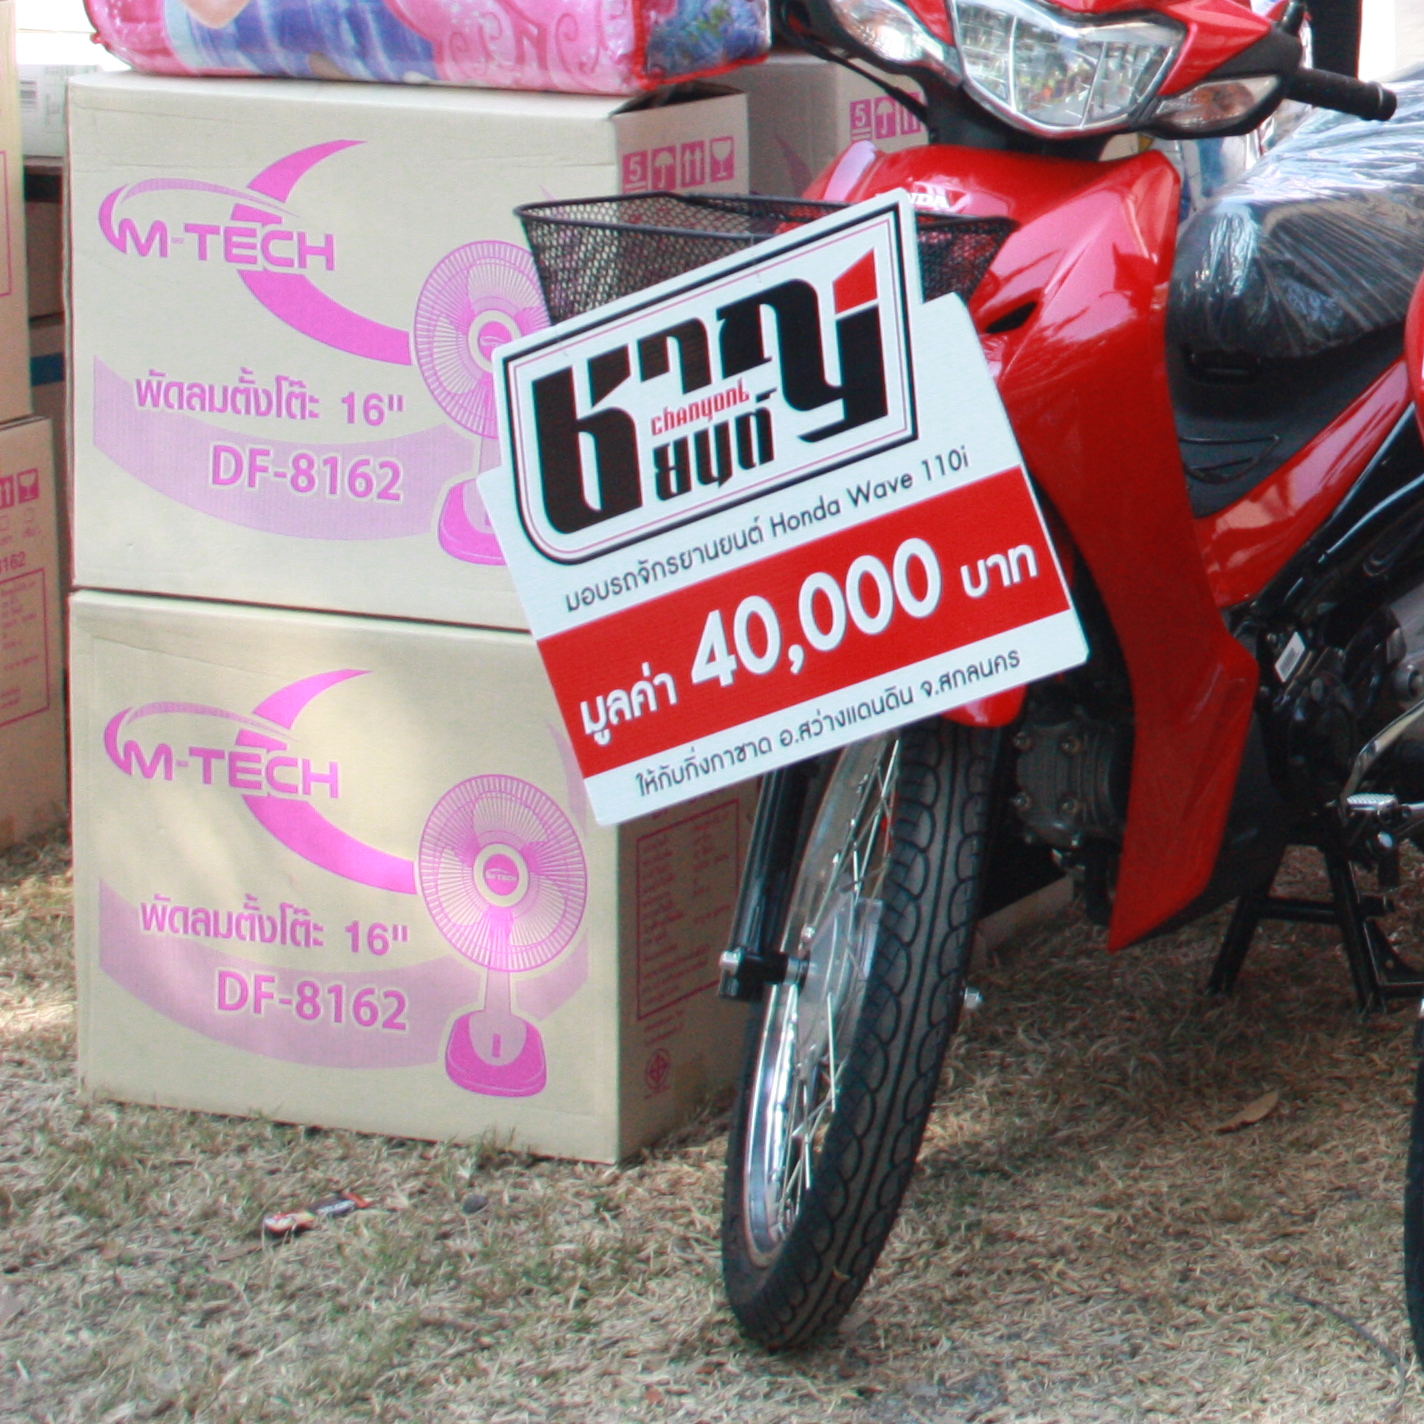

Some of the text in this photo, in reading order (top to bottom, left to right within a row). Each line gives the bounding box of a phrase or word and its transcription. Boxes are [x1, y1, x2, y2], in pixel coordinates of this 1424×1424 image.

[628, 155, 643, 183] 5
[906, 192, 950, 208] NDA
[118, 217, 336, 271] M-TECH
[135, 367, 404, 427] พัดลมตั้งโต๊ะ 16"
[211, 443, 403, 502] DF-8162
[653, 387, 777, 502] ยนต์
[565, 445, 970, 612] มอบรถจักรยานยนต์ Honda Wave 110i
[579, 537, 1040, 746] มูลค่า 40,000 บาท
[635, 648, 1021, 798] ให้กับกิ่งกาชาด อ.สว่างแดนดิน จ.สกลนคร
[123, 738, 340, 799] M-TECH
[140, 892, 410, 956] พัดลมตั้งโต๊ะ 16"
[217, 970, 408, 1031] DF-8162
